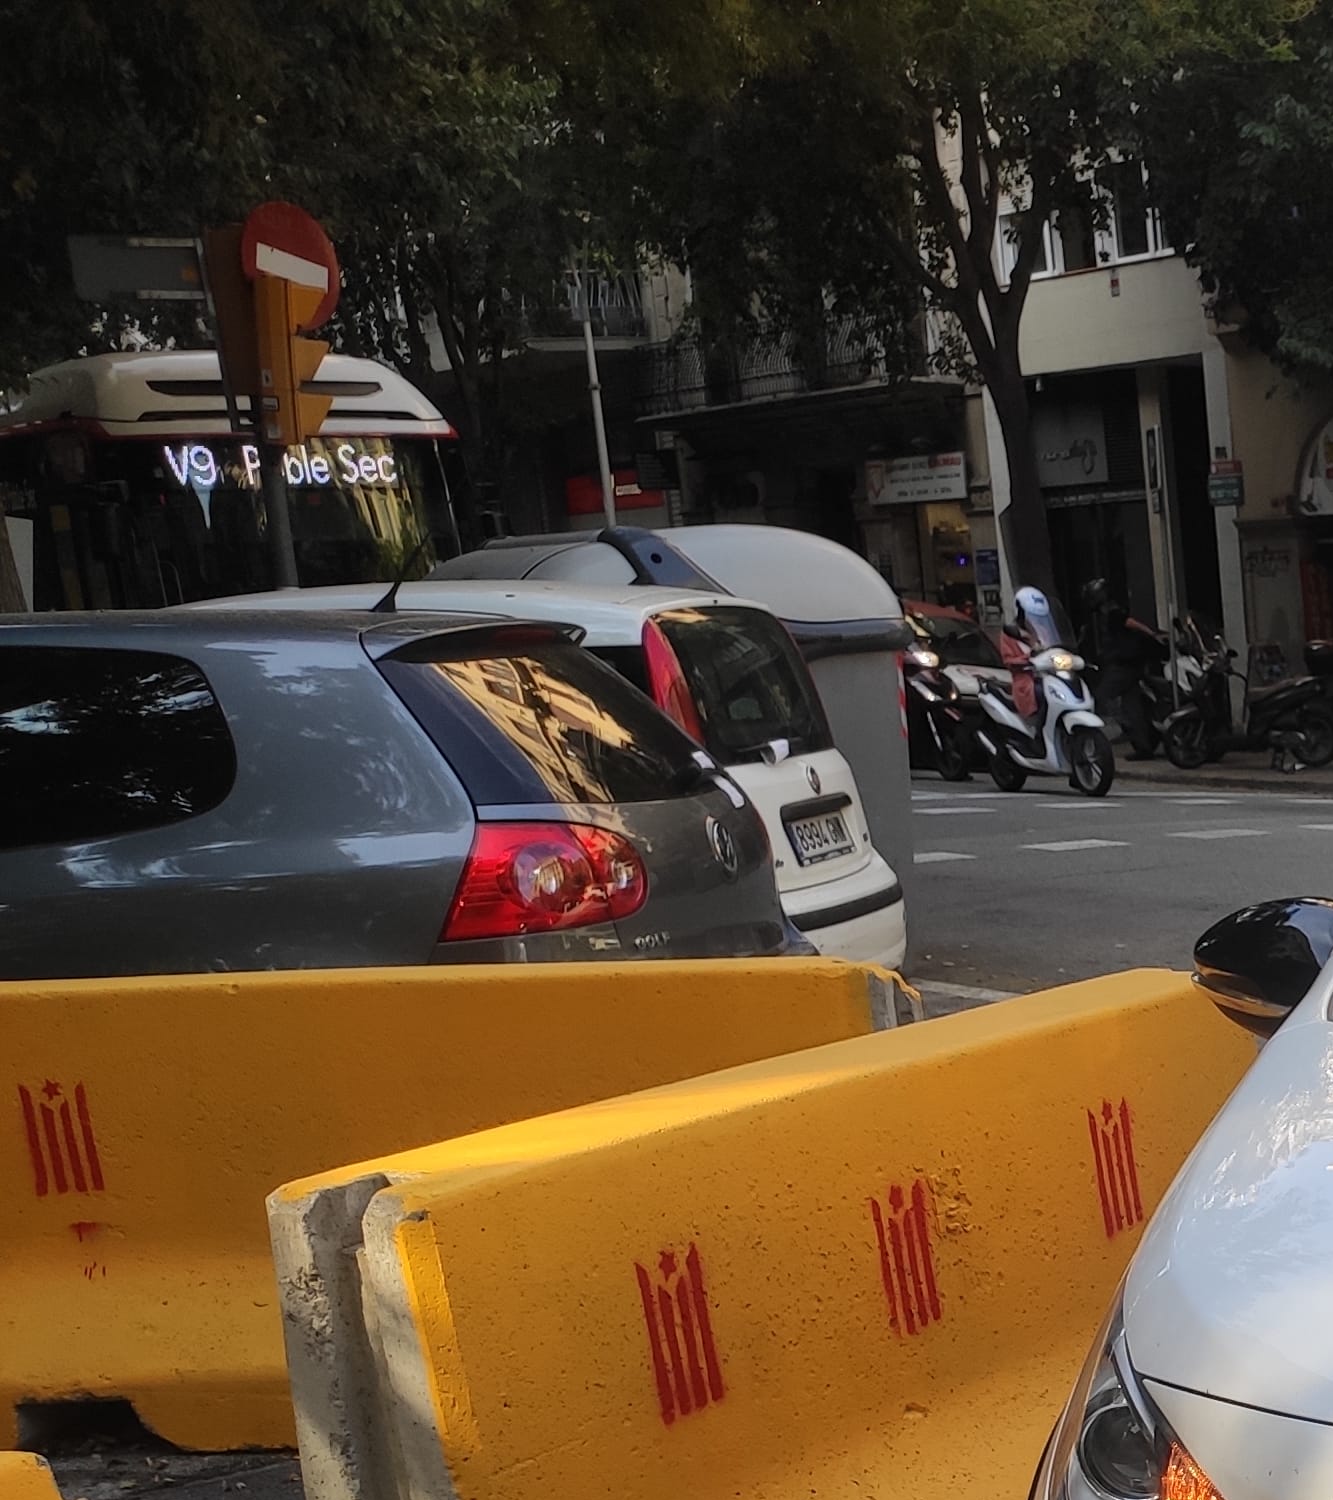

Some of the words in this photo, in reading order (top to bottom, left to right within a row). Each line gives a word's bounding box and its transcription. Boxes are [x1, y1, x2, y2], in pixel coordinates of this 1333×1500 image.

[242, 445, 330, 485] Pble
[337, 444, 397, 484] Sec
[796, 820, 830, 852] 8994
